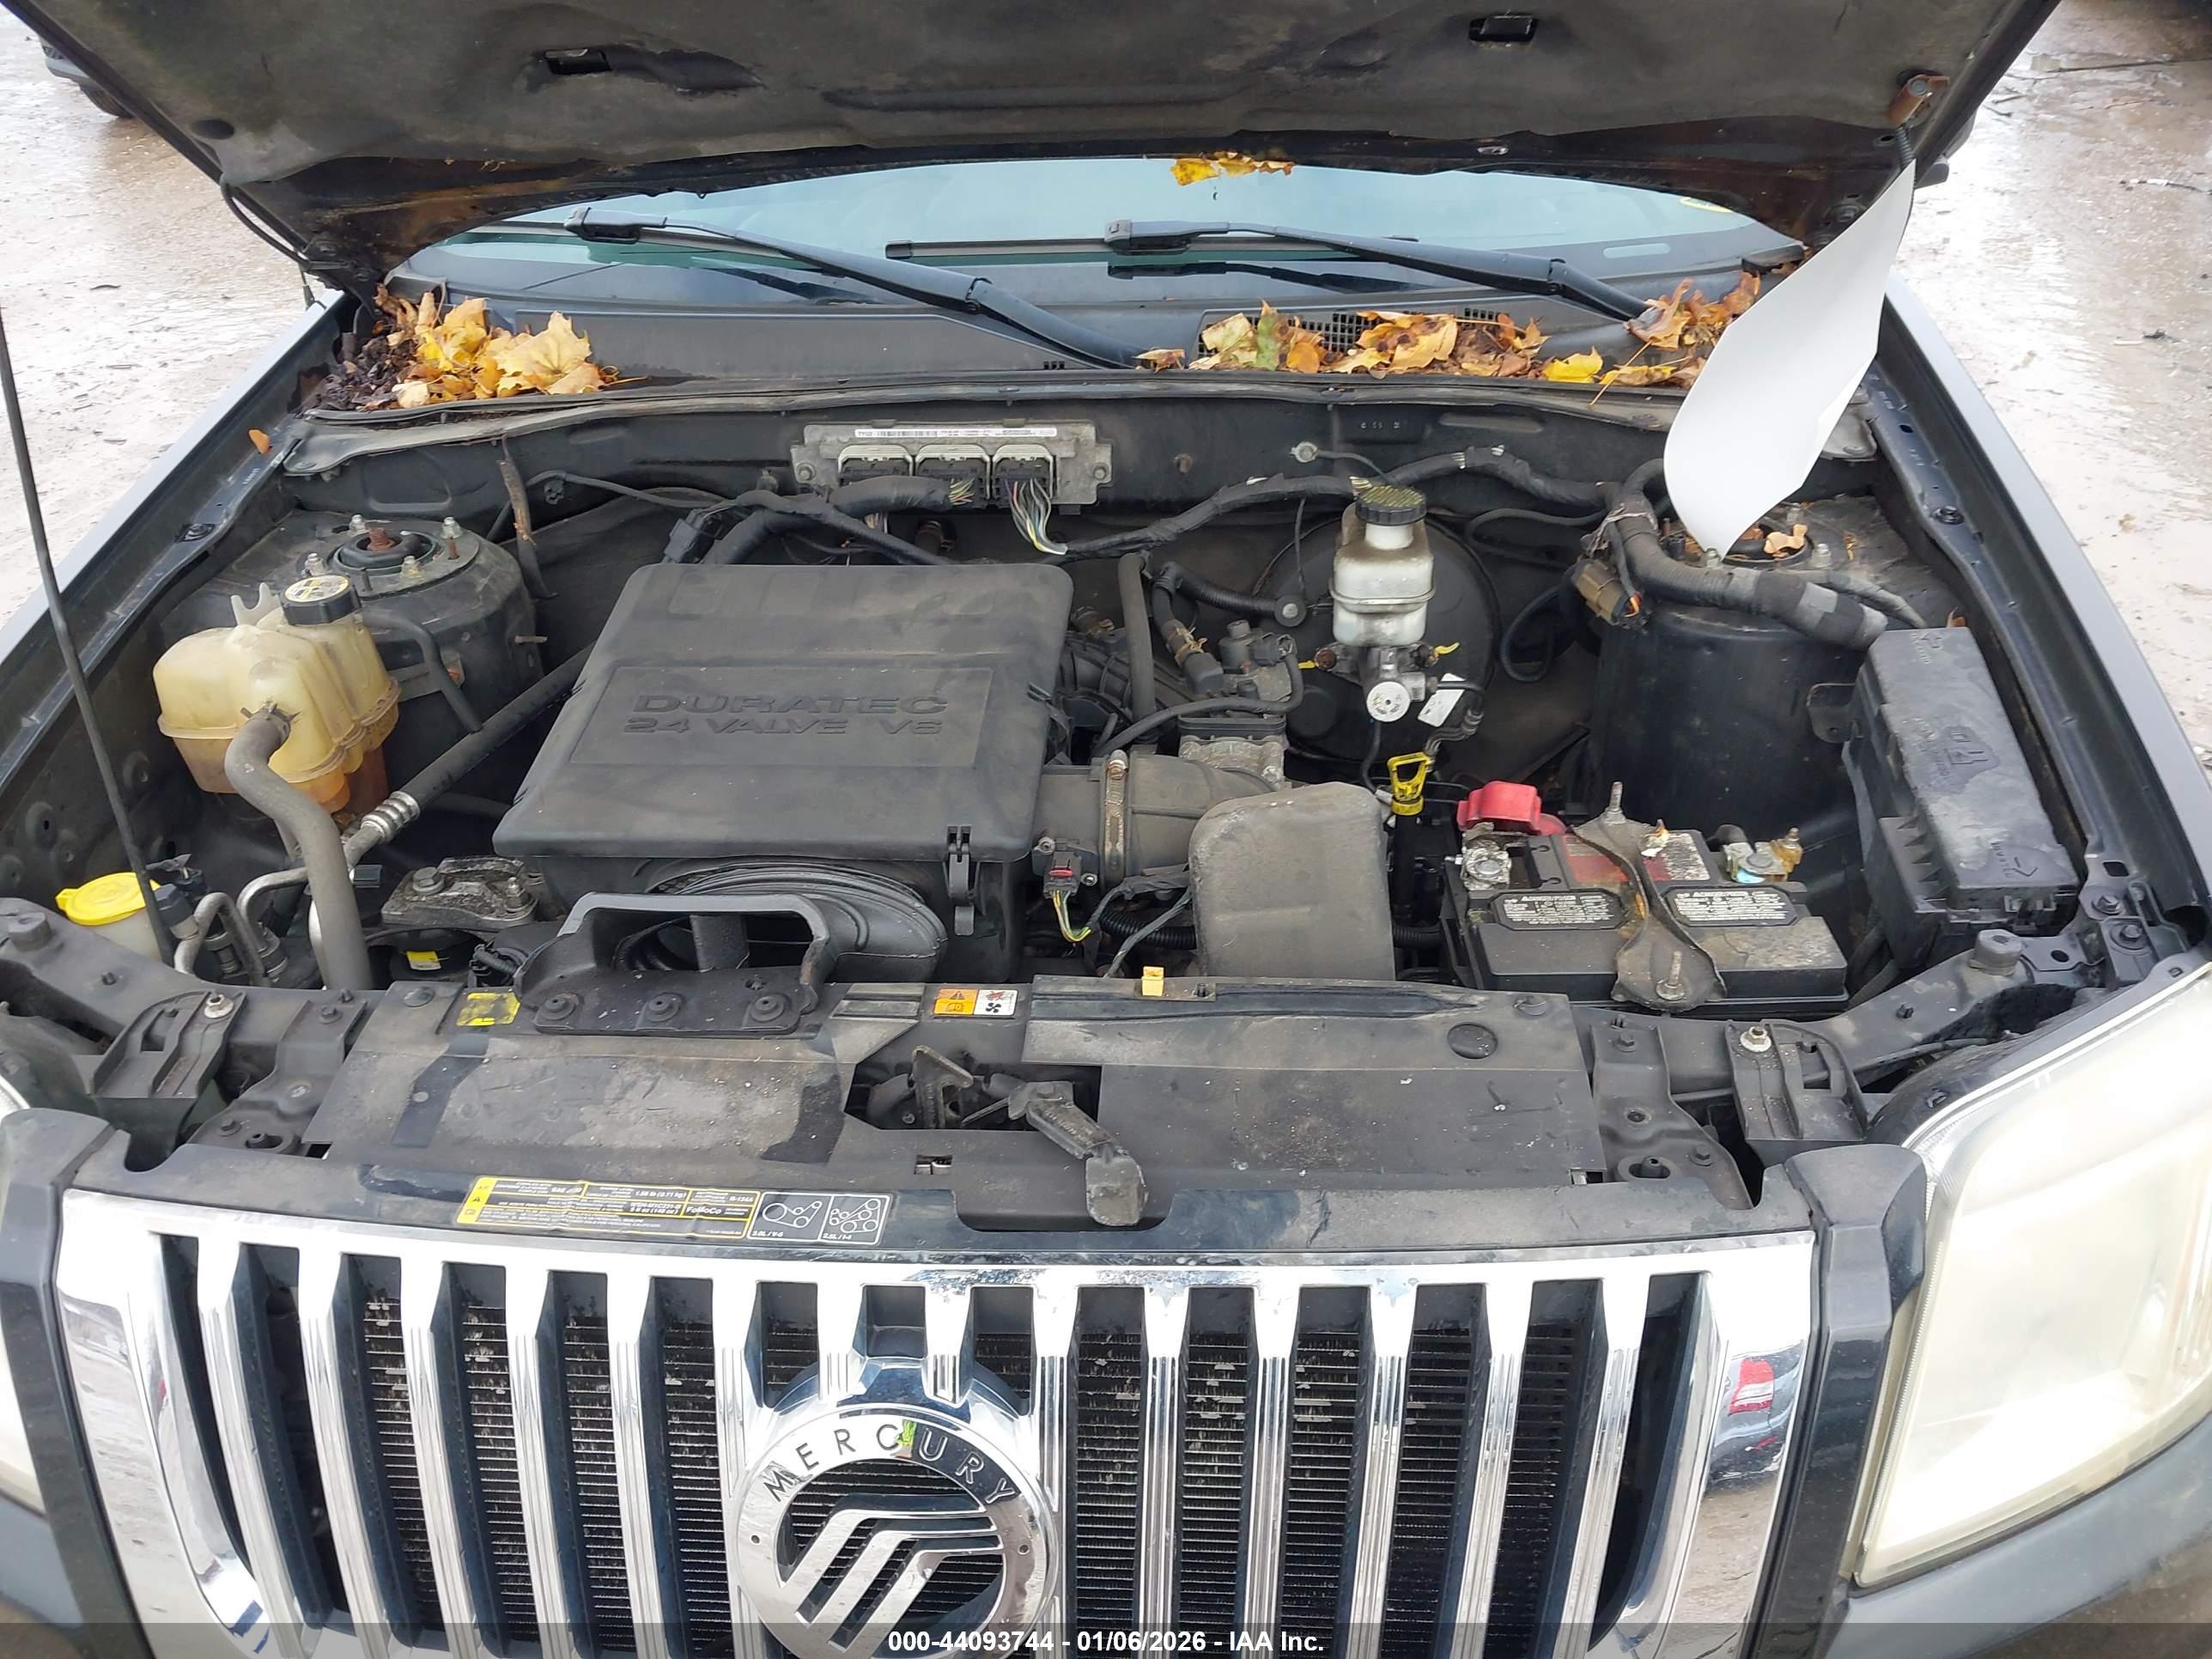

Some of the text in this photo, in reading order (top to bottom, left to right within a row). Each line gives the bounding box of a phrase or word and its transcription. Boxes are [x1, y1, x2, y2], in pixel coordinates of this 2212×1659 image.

[633, 694, 948, 714] DURATEC
[623, 717, 944, 736] 24 VALVE V6
[685, 1205, 722, 1215] FoMoCo
[762, 1423, 1020, 1505] MERCURY
